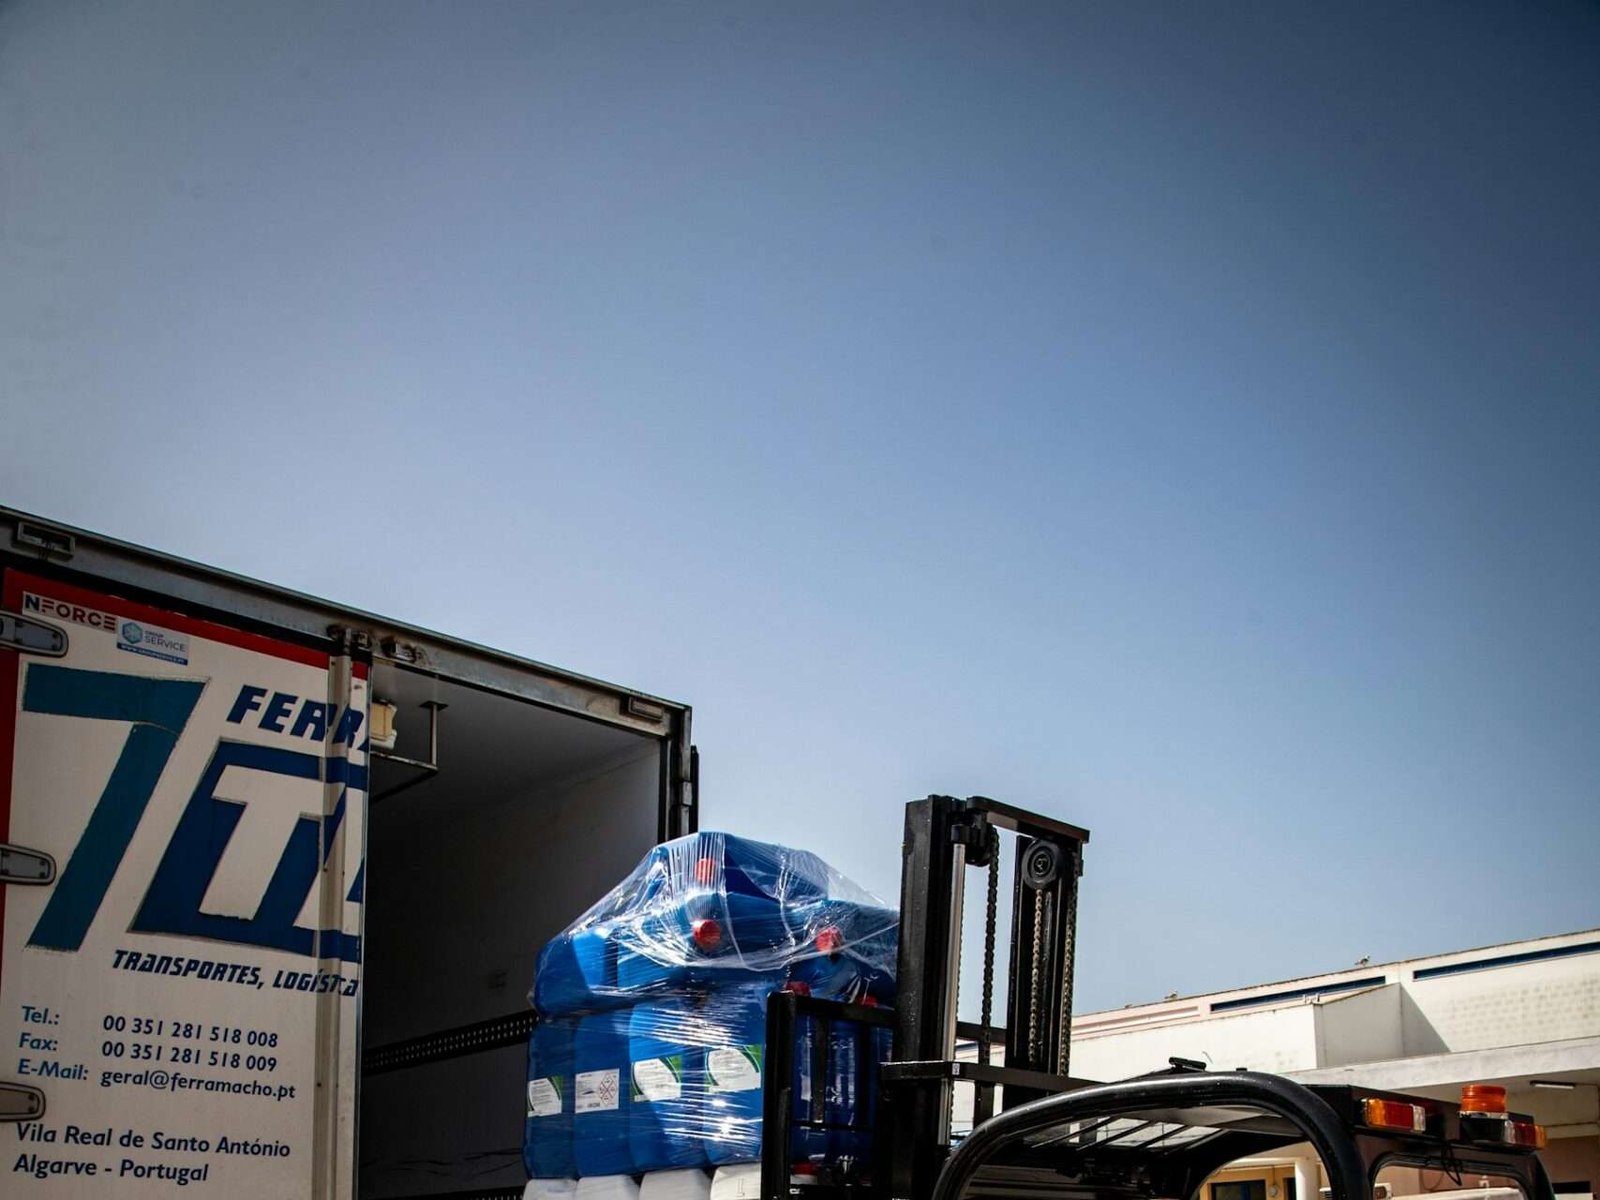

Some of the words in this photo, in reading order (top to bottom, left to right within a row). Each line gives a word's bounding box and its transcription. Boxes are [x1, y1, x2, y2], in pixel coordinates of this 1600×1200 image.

[144, 635, 186, 653] SERVICE
[226, 684, 370, 752] FERR
[113, 949, 264, 990] TRANSPORTES,
[272, 969, 359, 997] LOGÍSTA
[22, 1006, 59, 1025] Tel.:
[103, 1015, 126, 1032] 00
[131, 1018, 163, 1036] 351
[171, 1022, 202, 1039] 281
[210, 1026, 242, 1044] 518
[247, 1030, 278, 1048] 008
[19, 1032, 58, 1051] Fax:
[102, 1041, 125, 1058] 00
[130, 1043, 162, 1061] 351
[170, 1047, 201, 1064] 281
[208, 1051, 241, 1069] 518
[246, 1055, 277, 1072] 009
[18, 1058, 88, 1080] E-Mail:
[101, 1070, 296, 1101] geral@ferramacho.pt
[16, 1122, 56, 1143] Vila
[64, 1125, 113, 1147] Real
[119, 1129, 144, 1148] de
[151, 1131, 210, 1153] Santo
[215, 1136, 291, 1158] António
[13, 1153, 97, 1179] Algarve
[119, 1158, 209, 1186] Portugal
